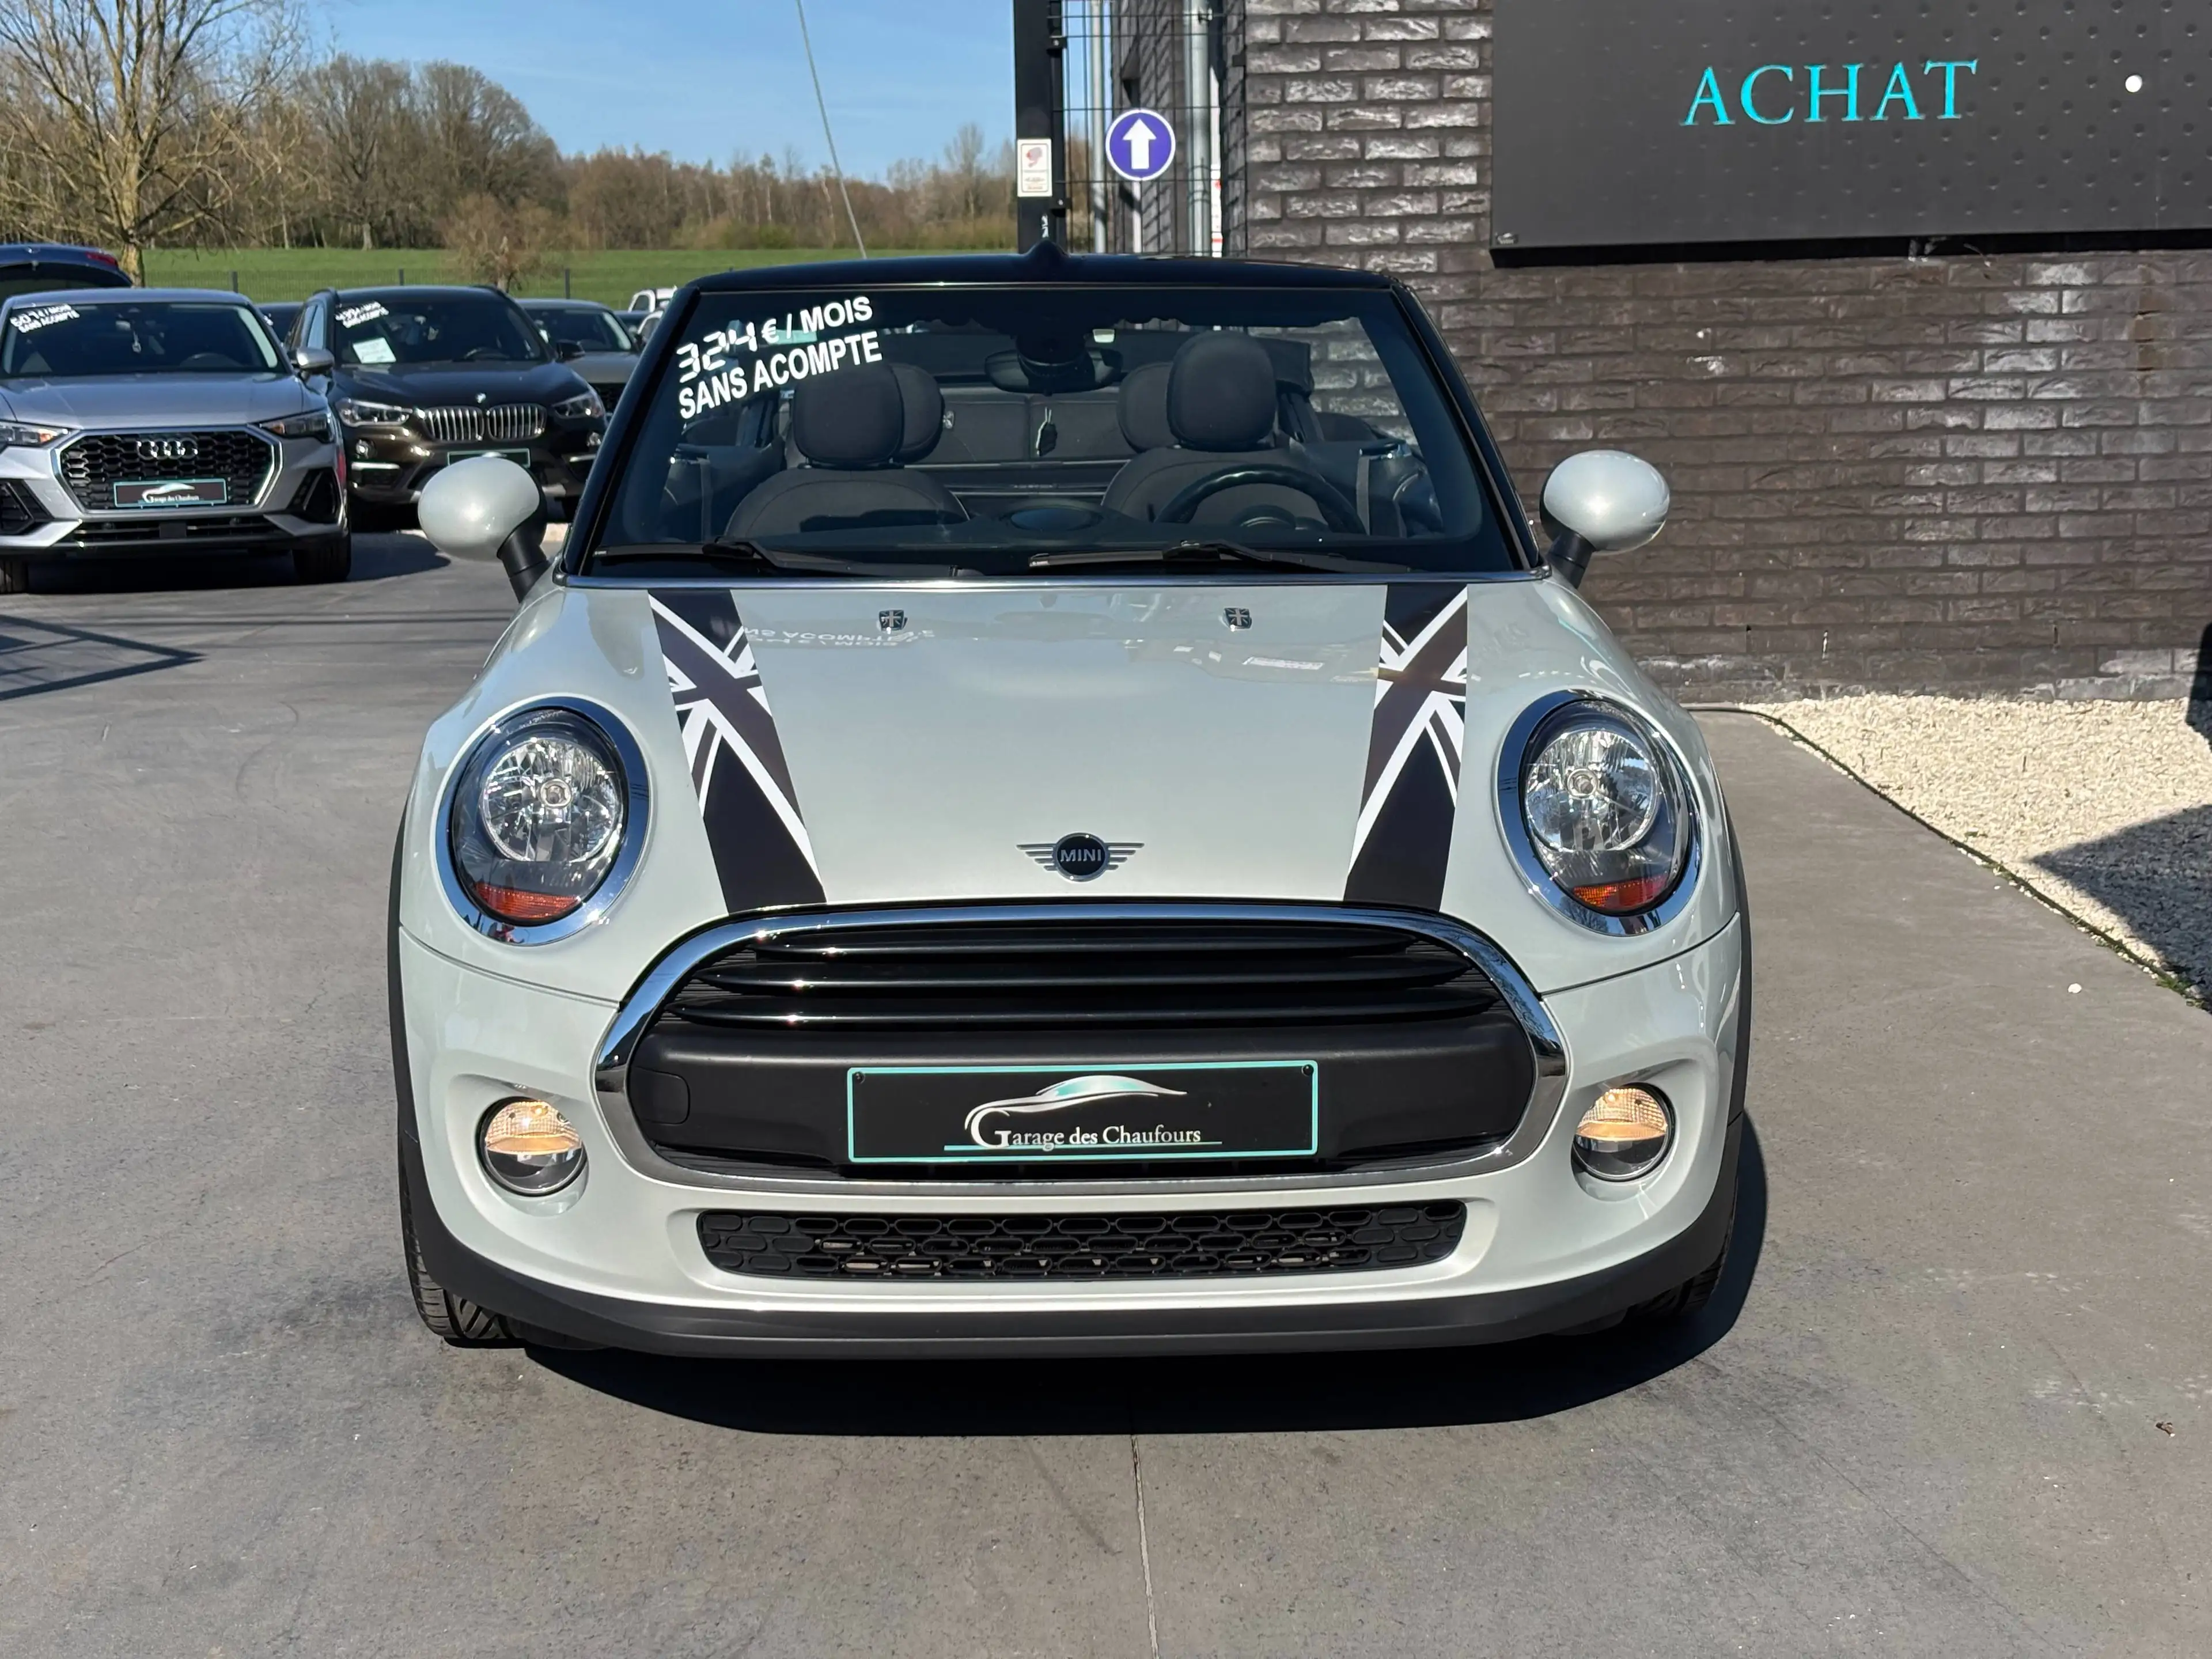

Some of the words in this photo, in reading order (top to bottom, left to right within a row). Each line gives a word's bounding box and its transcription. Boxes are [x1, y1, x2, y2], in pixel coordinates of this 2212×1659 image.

[1679, 58, 1979, 126] ACHAT
[800, 296, 873, 333] MOIS
[679, 364, 748, 419] SANS
[753, 331, 882, 392] ACOMPTE
[1060, 849, 1101, 862] MINI
[971, 1109, 1065, 1151] Garage
[1069, 1126, 1099, 1145] des
[1103, 1124, 1201, 1145] Chaufours
